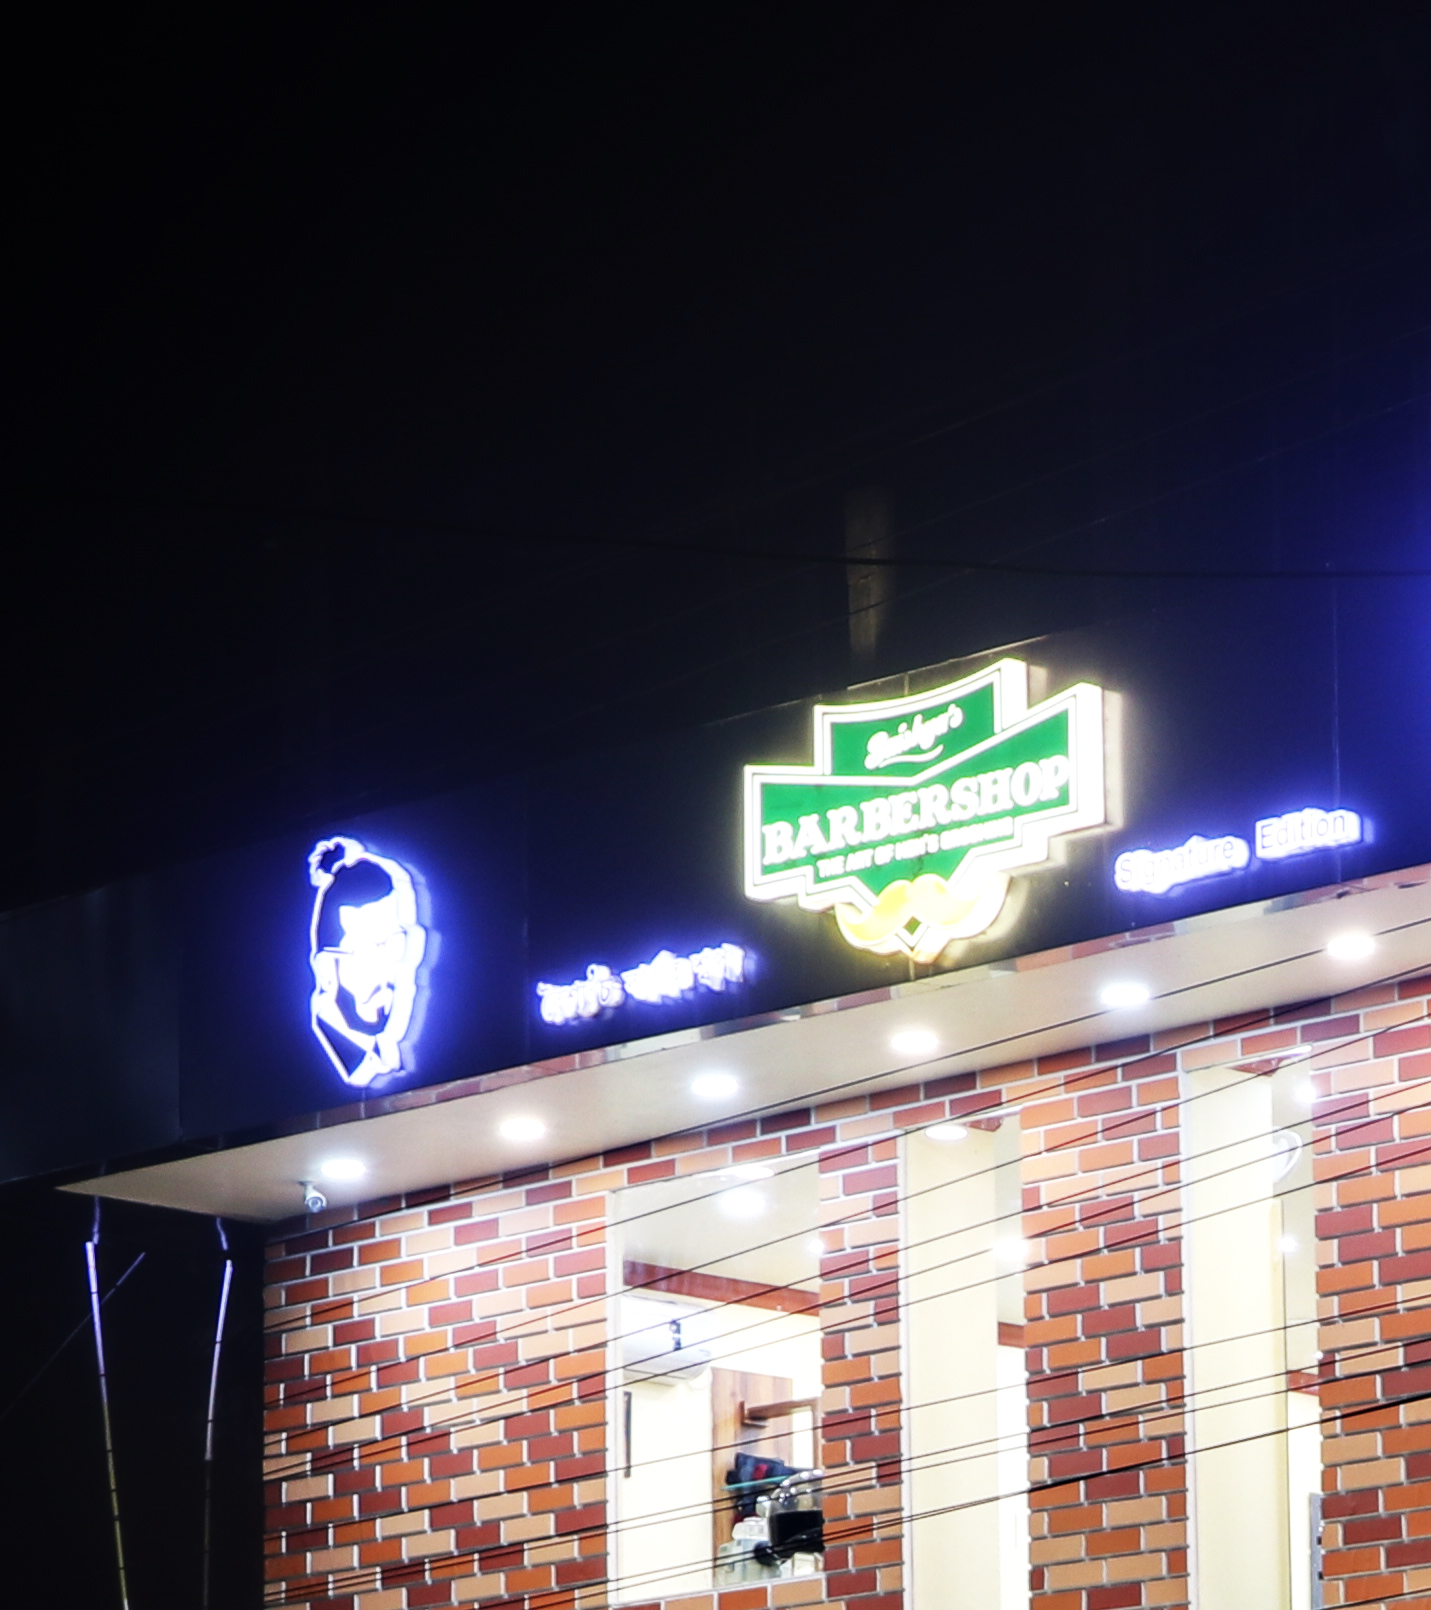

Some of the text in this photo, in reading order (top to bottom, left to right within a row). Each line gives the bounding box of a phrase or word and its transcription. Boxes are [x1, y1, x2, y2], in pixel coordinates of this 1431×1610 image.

[762, 753, 1071, 867] BARBERSHOP
[1115, 808, 1358, 893] Signature Edition
